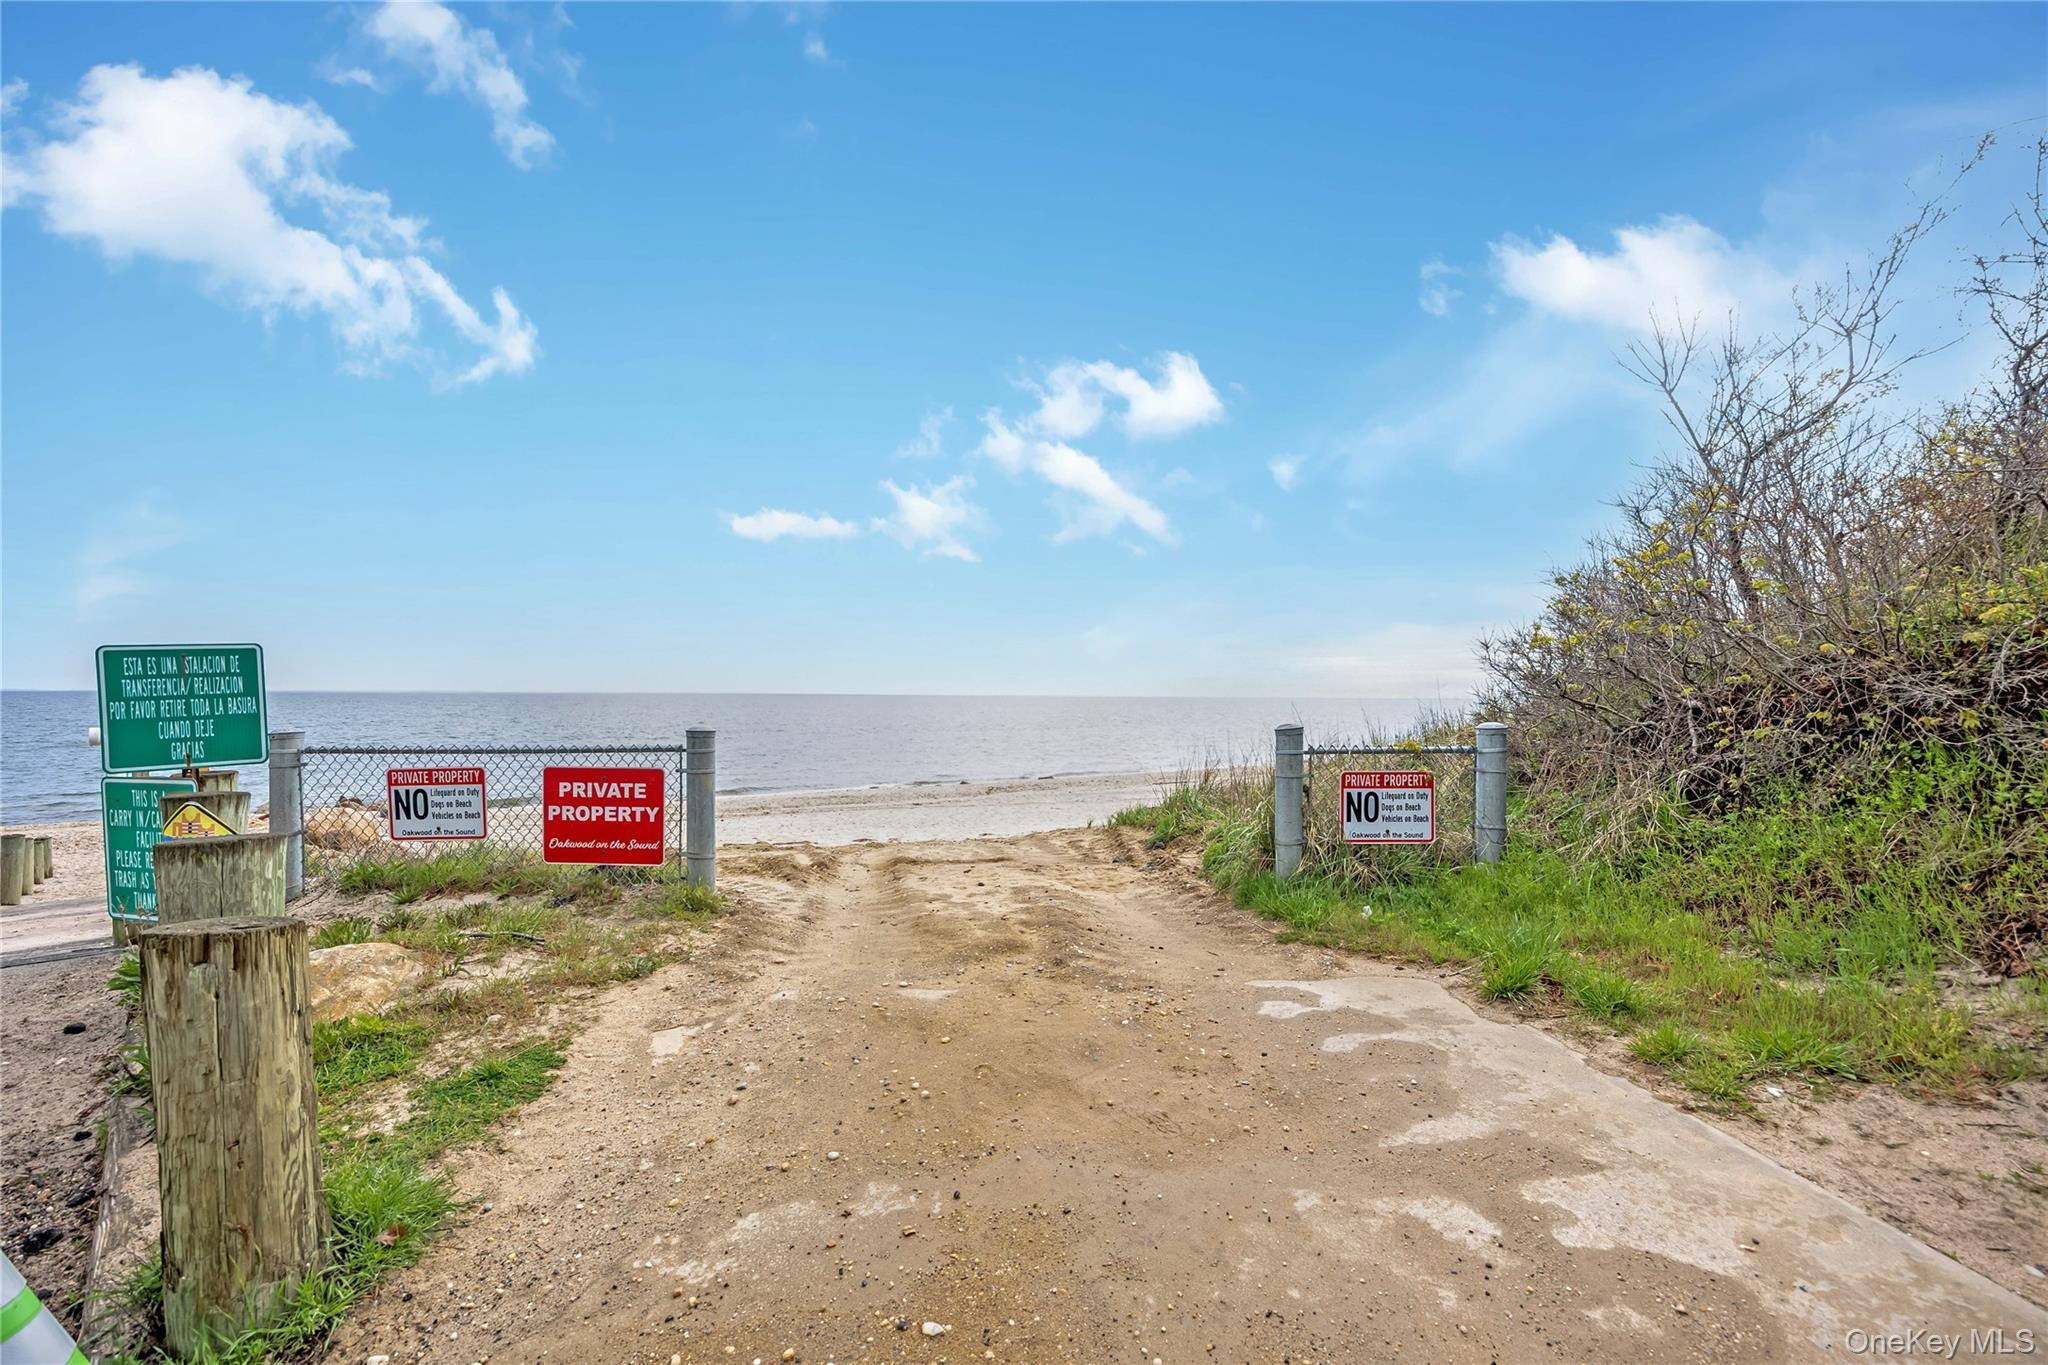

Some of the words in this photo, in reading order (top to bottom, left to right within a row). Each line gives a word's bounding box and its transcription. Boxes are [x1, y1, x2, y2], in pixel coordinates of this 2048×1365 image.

[124, 657, 143, 676] ESTA
[147, 657, 156, 675] ES
[160, 656, 178, 674] UNA
[230, 655, 240, 672] DE
[194, 676, 244, 695] REALIZACION
[110, 702, 126, 720] POR
[130, 700, 156, 719] FAVOR
[160, 699, 186, 718] RETIRE
[190, 698, 210, 716] TODA
[214, 698, 224, 715] LA
[228, 696, 258, 714] BASURA
[158, 720, 190, 739] CUANDO
[195, 720, 214, 736] DEJE
[171, 740, 204, 760] GRACIAS
[392, 771, 429, 784] PRIVATE
[432, 770, 480, 783] PROPERTY
[1344, 774, 1380, 786] PRIVATE
[132, 790, 148, 808] THIS
[150, 790, 159, 808] IS
[430, 788, 456, 798] Lifeguard
[466, 788, 480, 797] Duty
[559, 782, 647, 798] PRIVATE
[1382, 792, 1406, 801] Lifeguard
[1416, 792, 1428, 800] Duty
[394, 788, 428, 820] NO
[431, 800, 444, 809] Dogs
[1346, 792, 1380, 822] NO
[1382, 803, 1394, 812] Dogs
[110, 810, 132, 828] CARRY
[136, 810, 163, 828] IN/CA
[432, 812, 454, 820] Vehicles
[465, 811, 480, 819] Beach
[548, 806, 660, 822] PROPERTY
[549, 838, 596, 848] Oakwood
[610, 840, 626, 849] the
[627, 839, 660, 850] Sound
[116, 850, 142, 868] PLEASE
[114, 870, 136, 888] TRASH
[140, 872, 150, 890] AS
